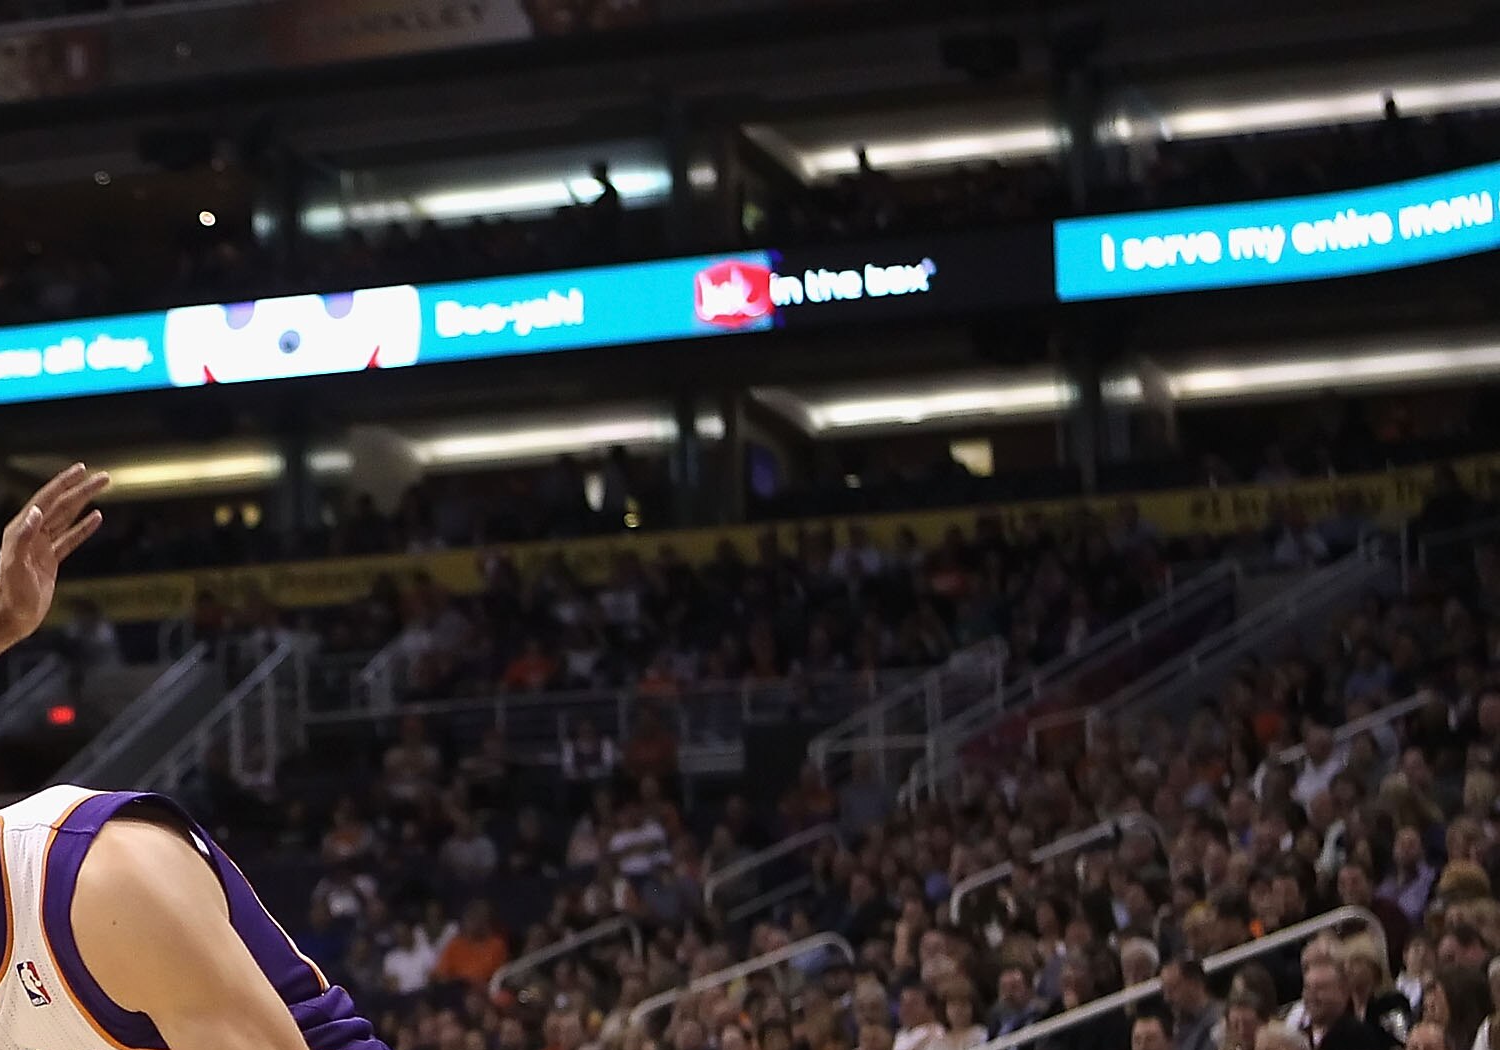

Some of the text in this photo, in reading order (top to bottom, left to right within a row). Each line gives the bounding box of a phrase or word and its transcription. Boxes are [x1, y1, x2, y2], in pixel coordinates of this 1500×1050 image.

[1122, 231, 1222, 271] serve
[1228, 224, 1286, 264] my
[1291, 208, 1394, 255] entire
[1398, 190, 1493, 240] menu
